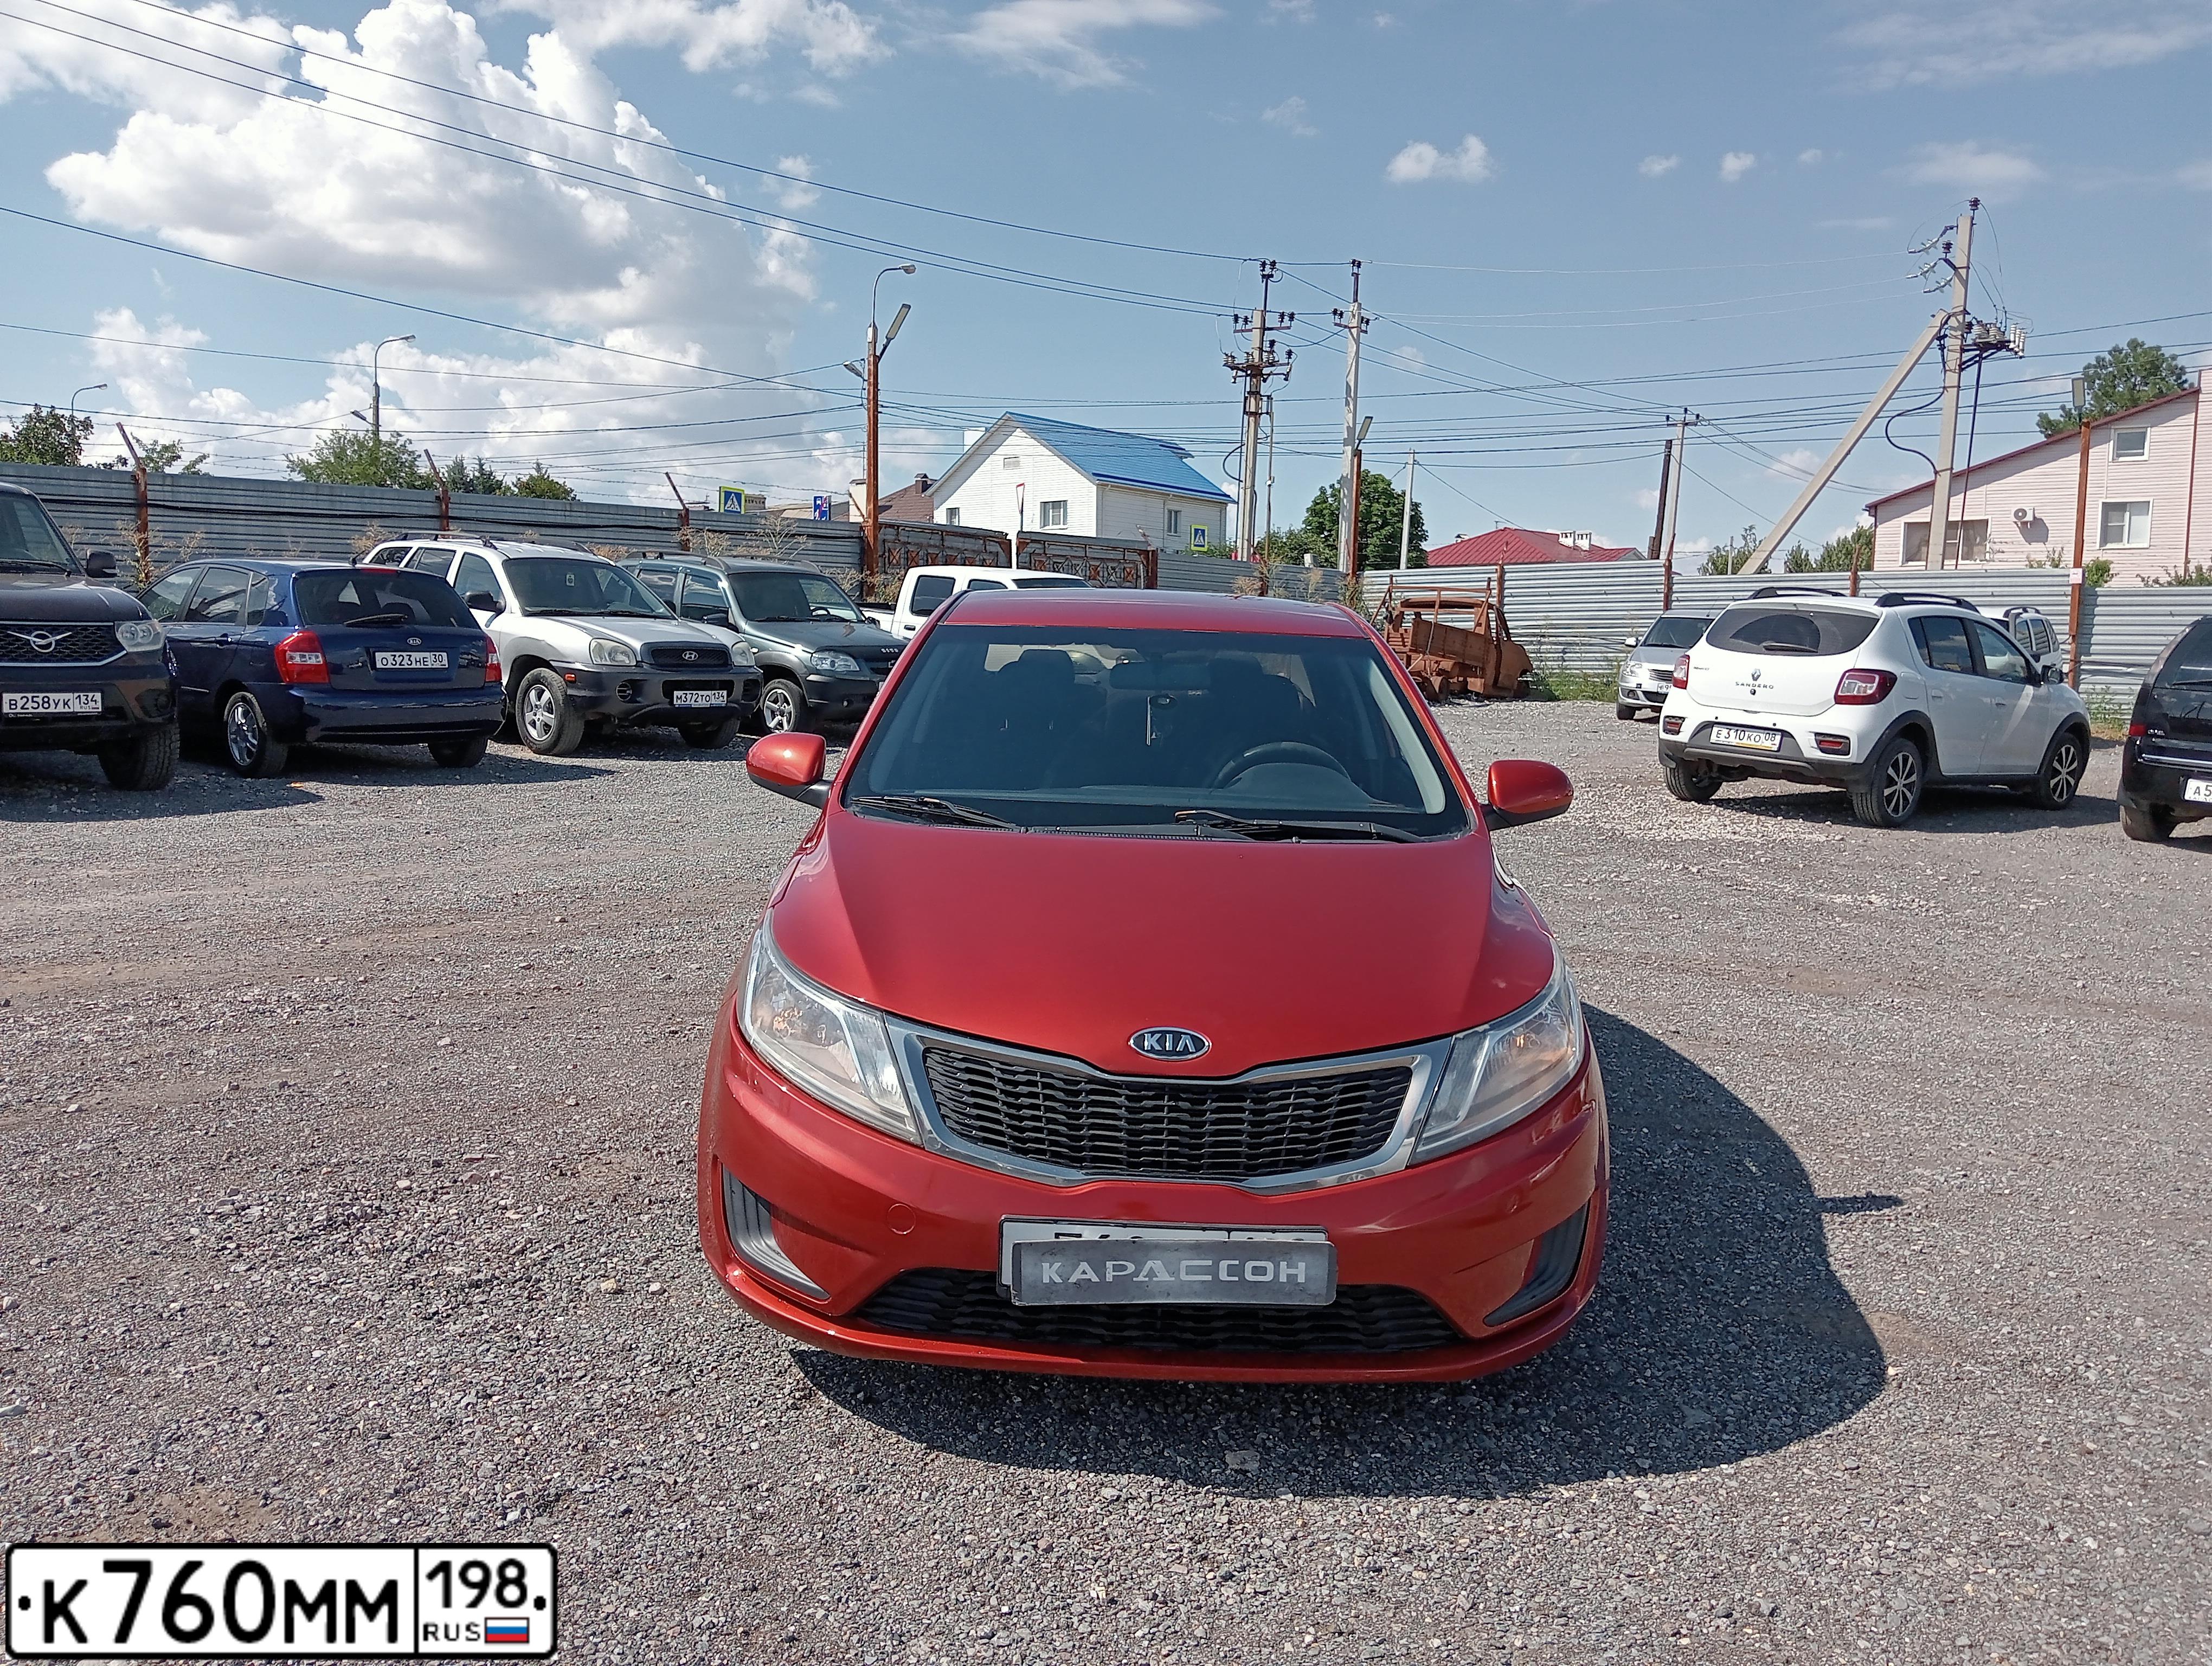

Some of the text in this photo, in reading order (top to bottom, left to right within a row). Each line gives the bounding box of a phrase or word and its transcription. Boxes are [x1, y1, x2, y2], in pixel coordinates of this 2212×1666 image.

[381, 654, 443, 666] О323НЕ 30
[9, 694, 97, 710] В258УК 134
[676, 692, 724, 703] М372ТО 134
[1765, 733, 1776, 741] 08
[1144, 1033, 1196, 1052] KIA
